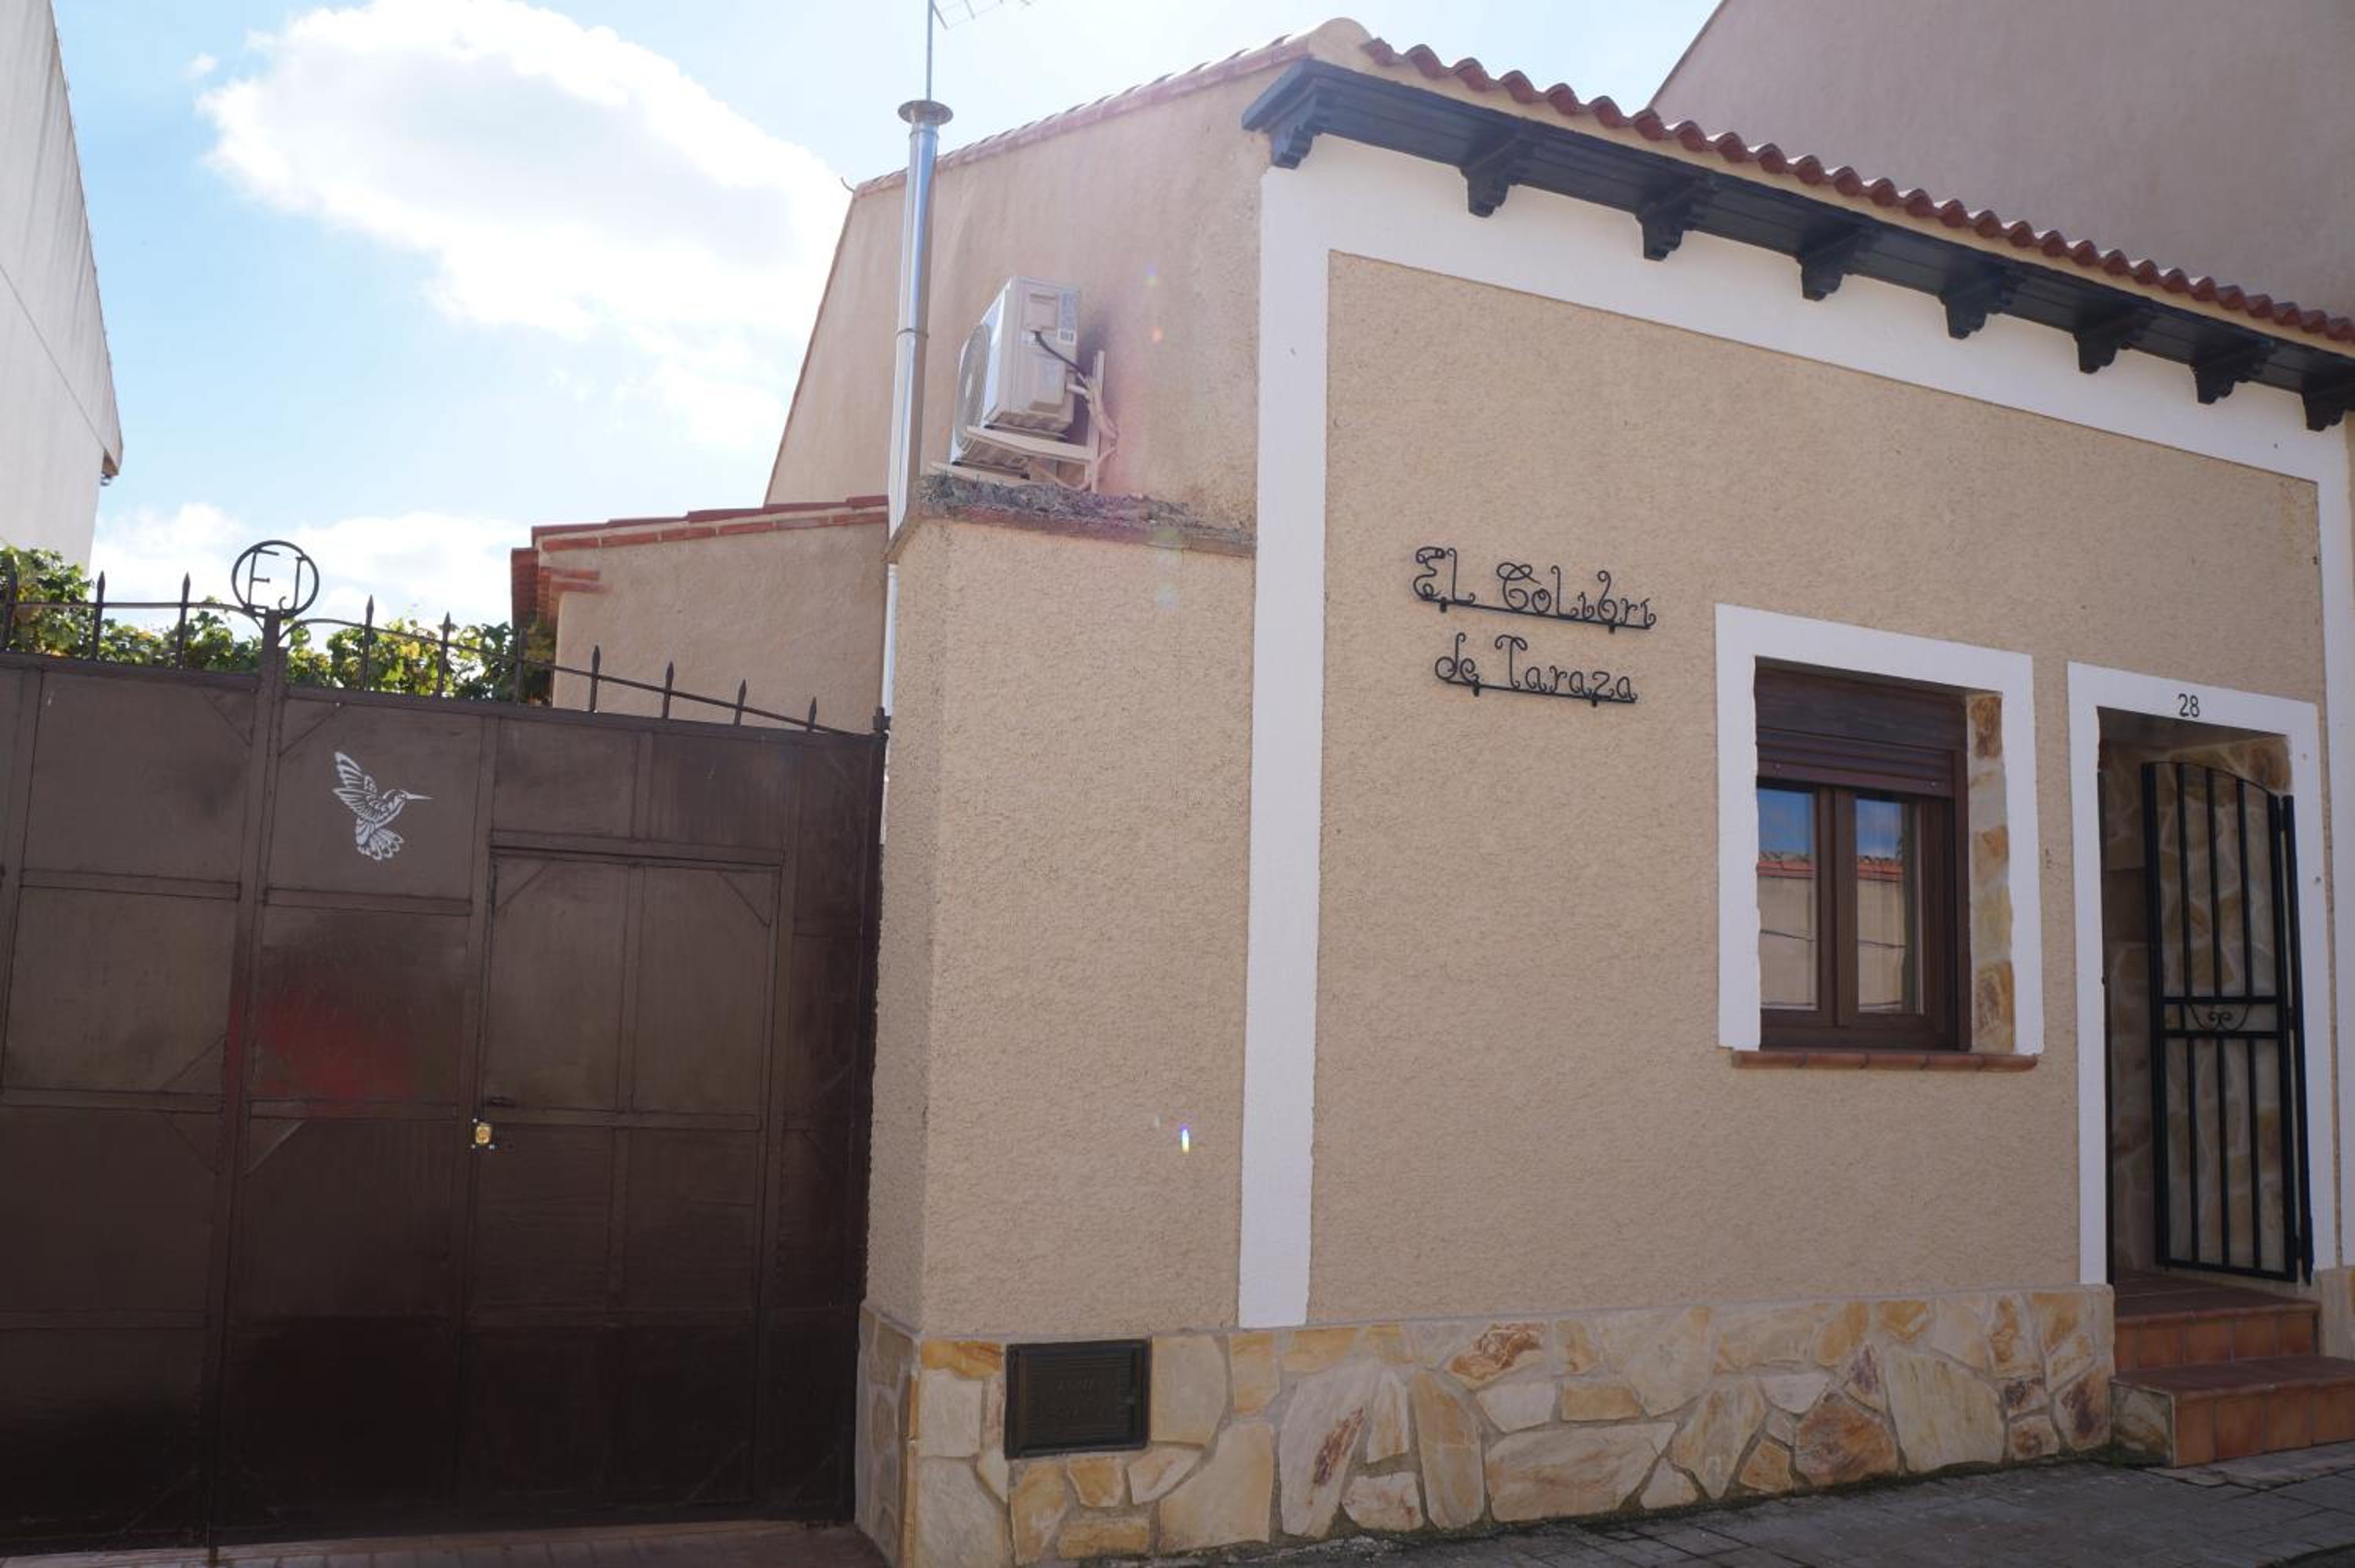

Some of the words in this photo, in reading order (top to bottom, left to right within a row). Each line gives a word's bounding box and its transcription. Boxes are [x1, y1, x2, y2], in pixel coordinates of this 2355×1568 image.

[1434, 632, 1480, 685] de
[1494, 634, 1638, 702] Taraza
[2178, 692, 2200, 717] 28
